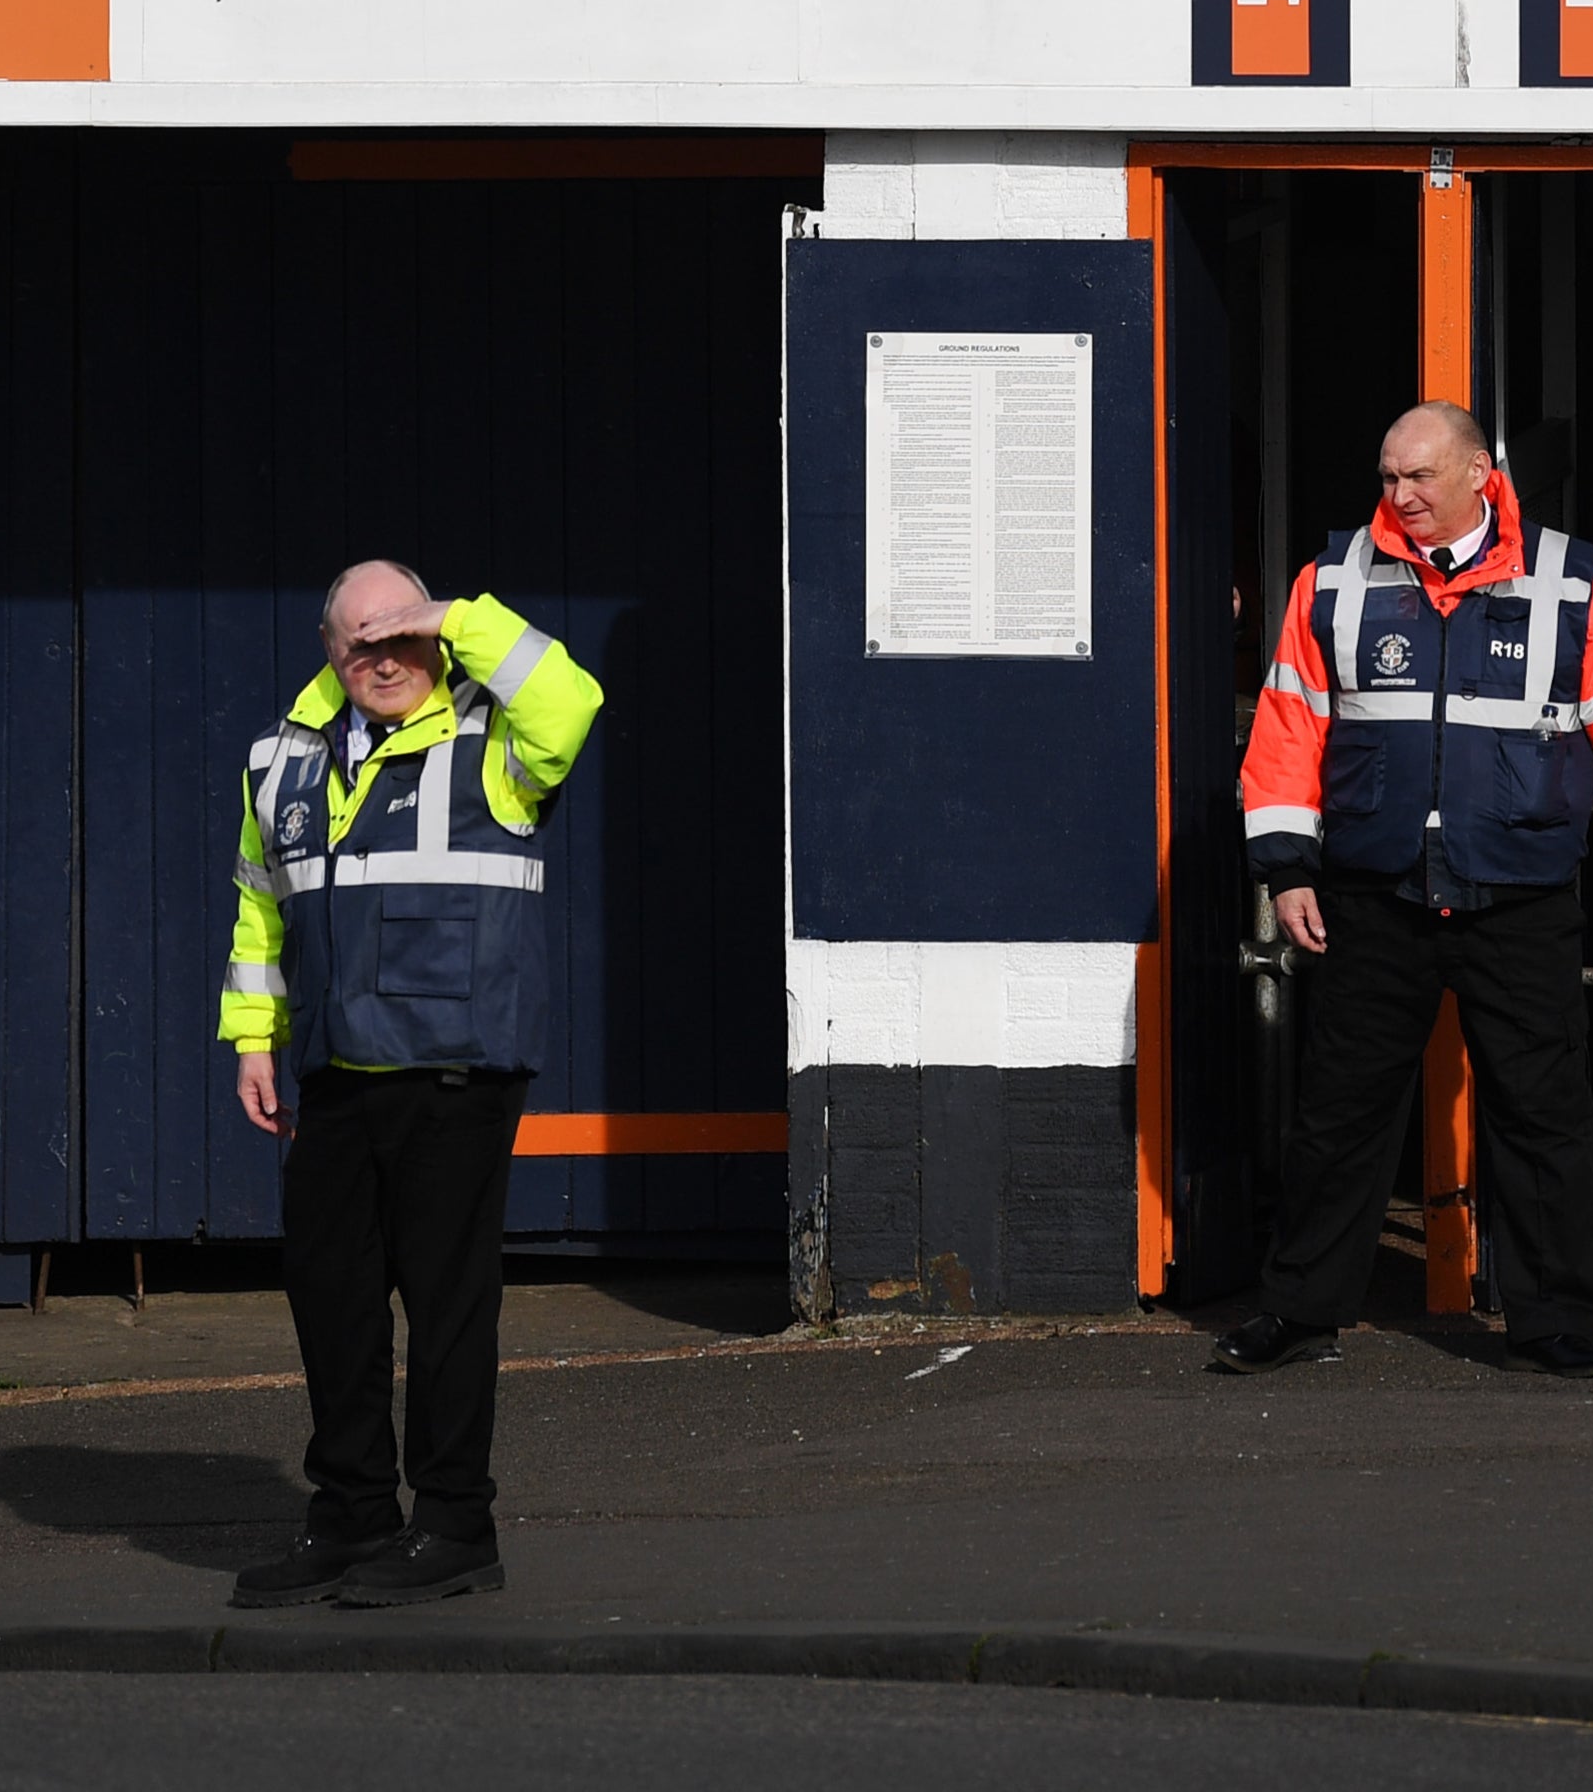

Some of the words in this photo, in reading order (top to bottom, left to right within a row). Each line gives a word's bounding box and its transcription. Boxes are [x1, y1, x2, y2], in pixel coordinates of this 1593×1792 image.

[938, 344, 969, 353] GROUND
[971, 344, 1020, 353] REGULATIONS
[1490, 640, 1524, 660] R18
